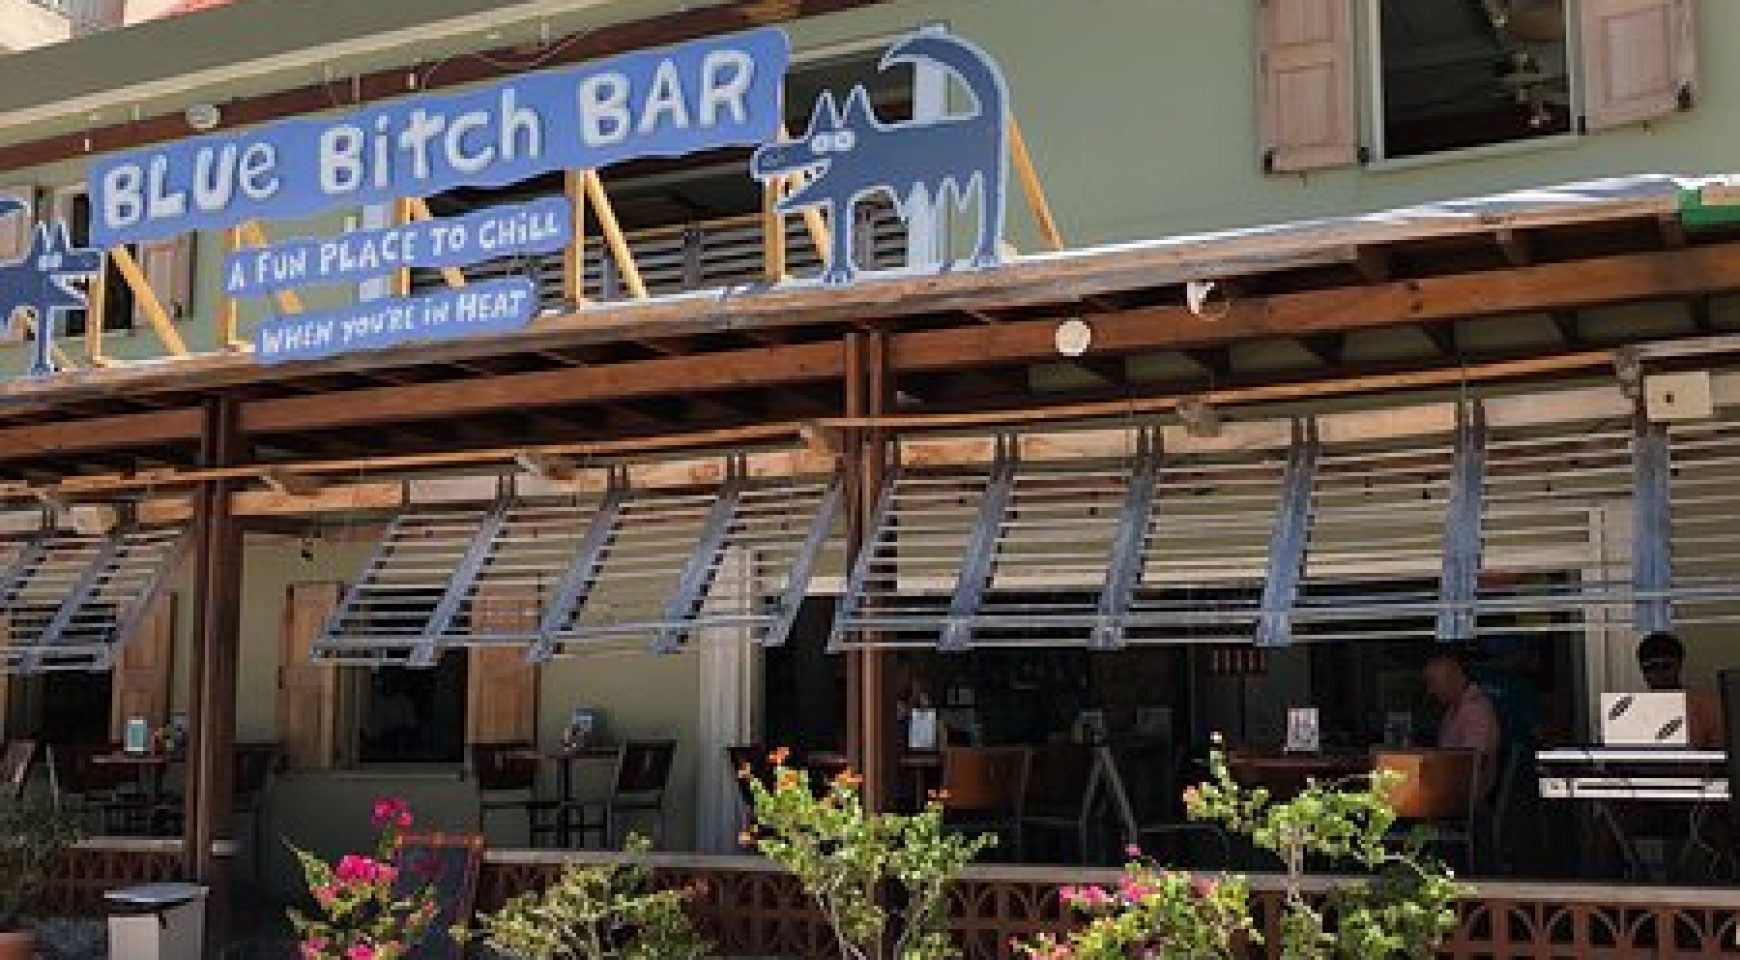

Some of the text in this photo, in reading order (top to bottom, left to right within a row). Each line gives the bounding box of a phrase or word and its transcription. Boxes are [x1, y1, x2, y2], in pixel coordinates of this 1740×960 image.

[579, 50, 755, 147] BAR
[227, 260, 245, 291] A
[255, 250, 306, 284] FUN
[320, 231, 416, 276] PLACE
[430, 223, 465, 256] TO
[262, 320, 334, 352] WHEN
[456, 289, 527, 322] HEAT
